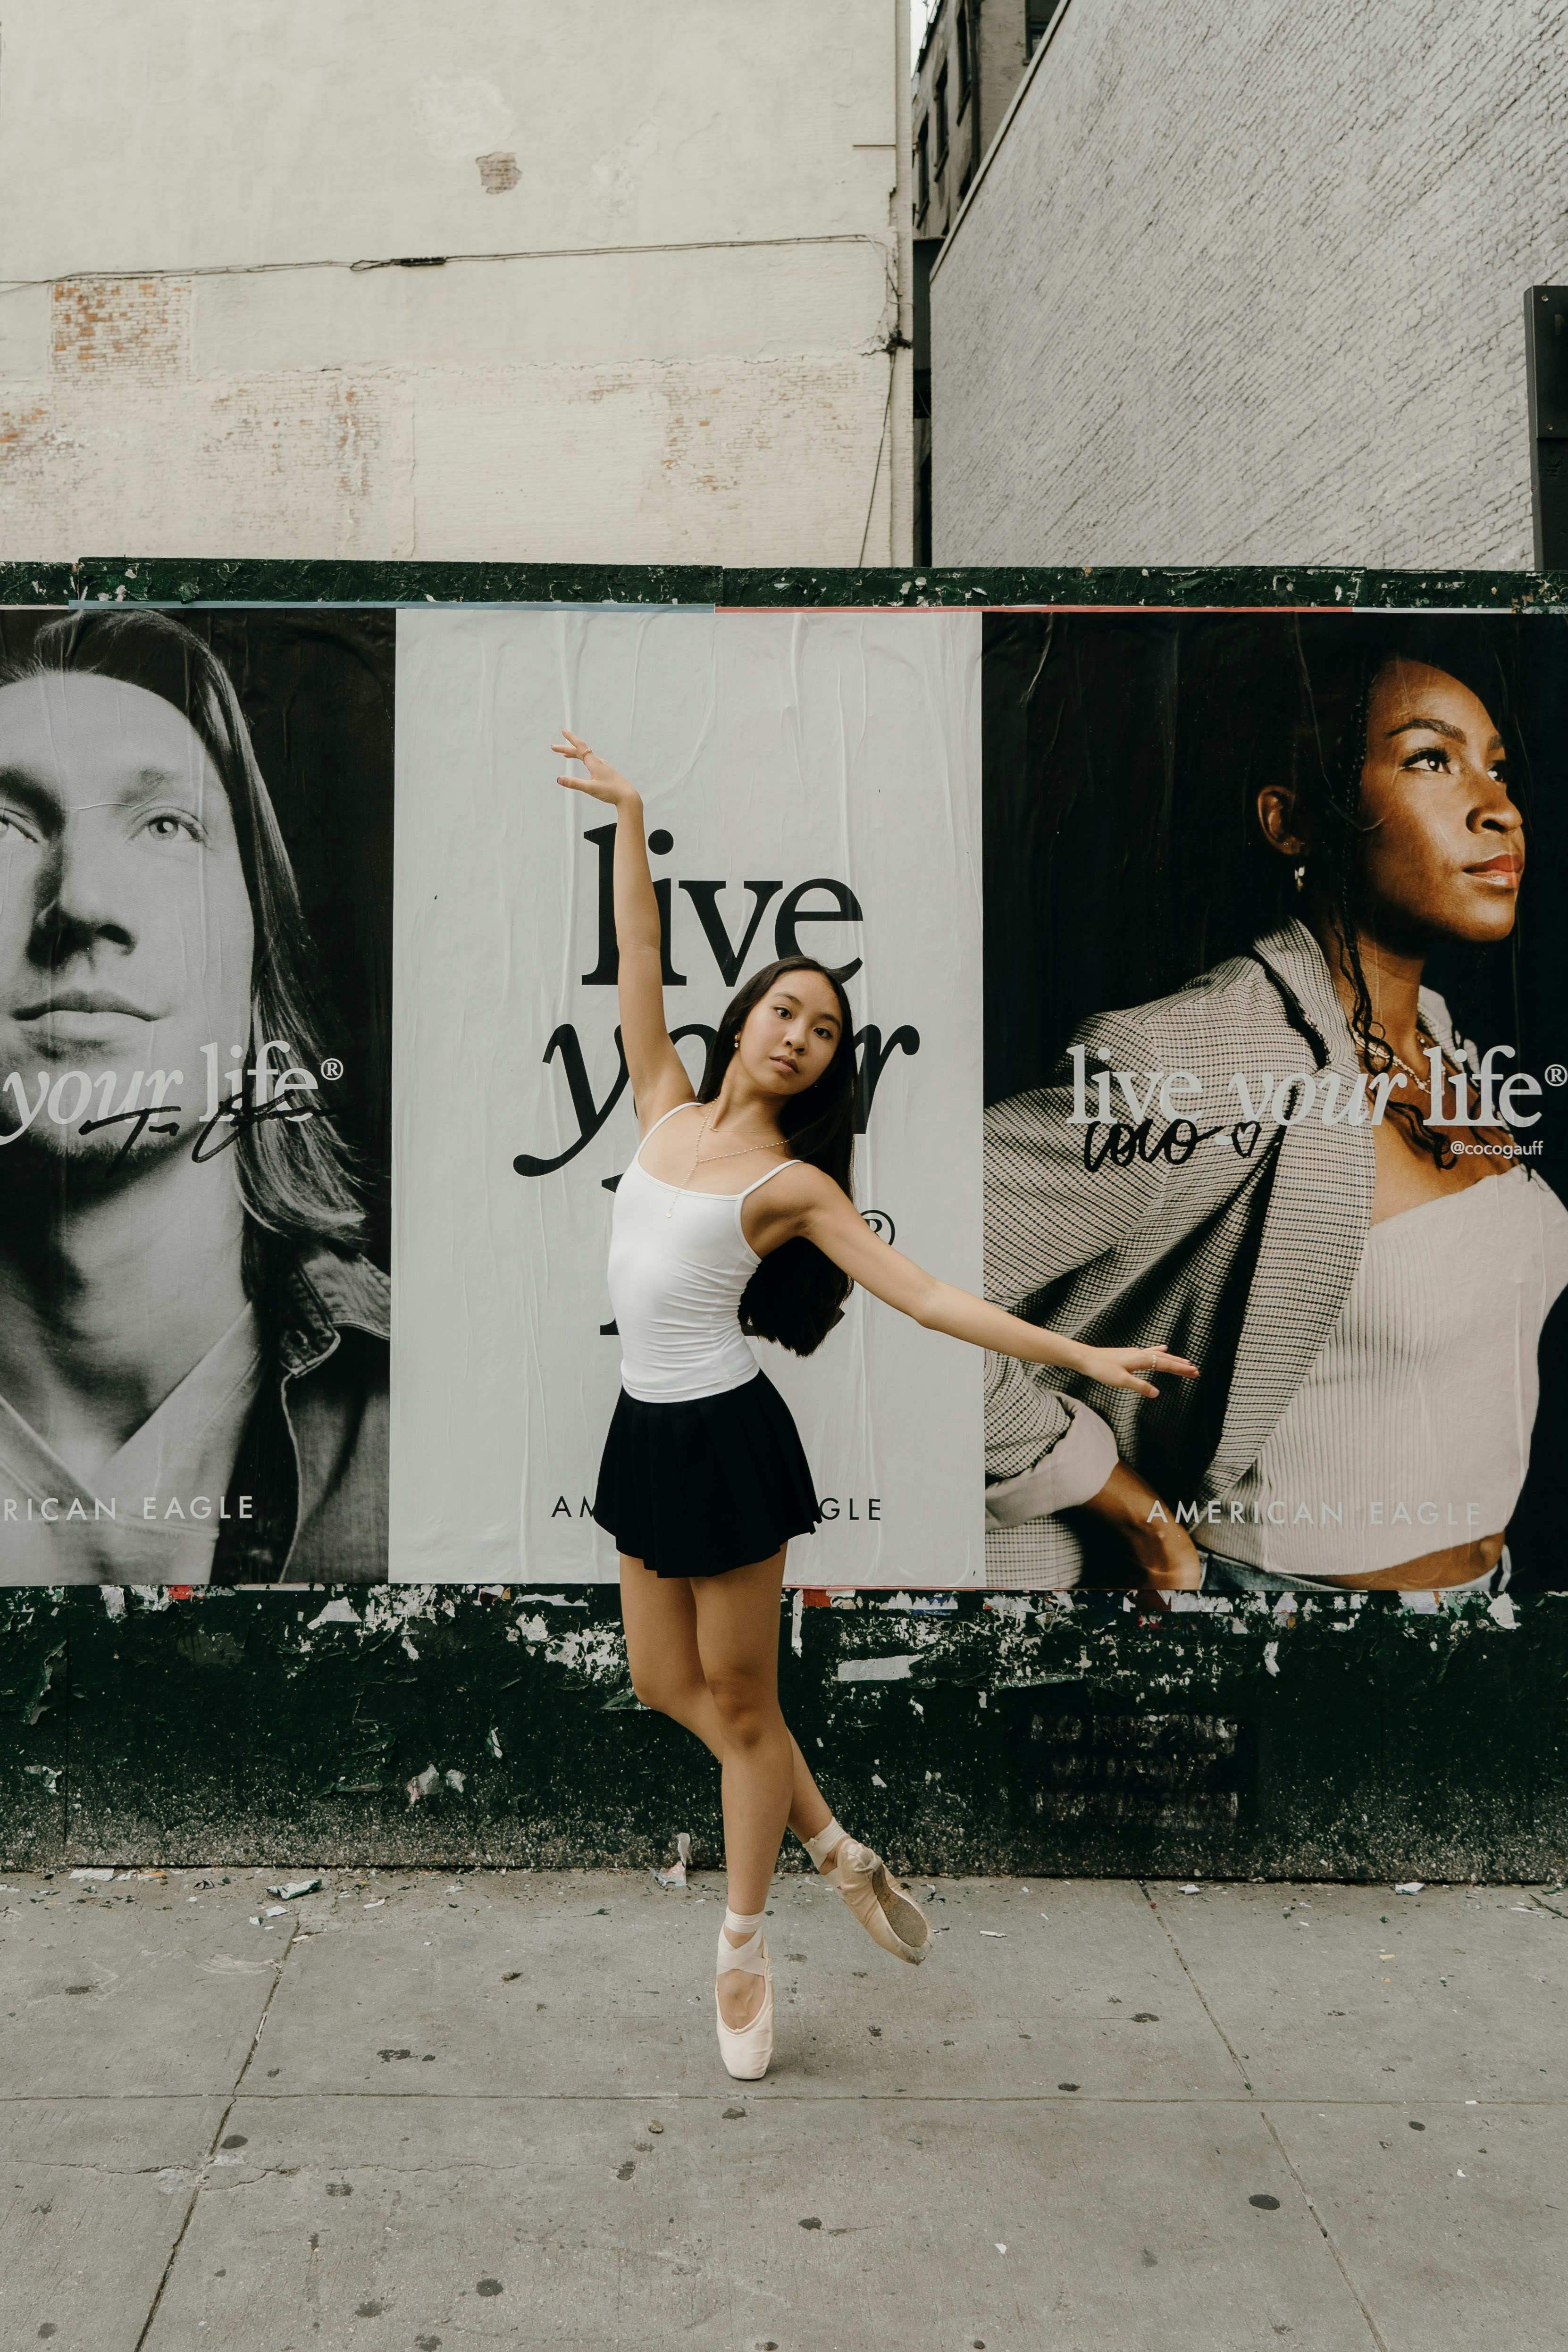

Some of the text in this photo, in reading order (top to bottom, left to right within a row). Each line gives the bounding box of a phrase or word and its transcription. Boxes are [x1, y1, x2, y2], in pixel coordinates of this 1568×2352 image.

[582, 822, 864, 987] live
[0, 1070, 184, 1145] your
[1066, 1044, 1203, 1125] live
[1215, 1072, 1408, 1146] your
[1450, 1140, 1544, 1159] @cocogauff
[143, 1496, 253, 1520] EAGLE
[819, 1498, 881, 1521] GLE
[1146, 1500, 1480, 1525] AMERICAN EAGLE
